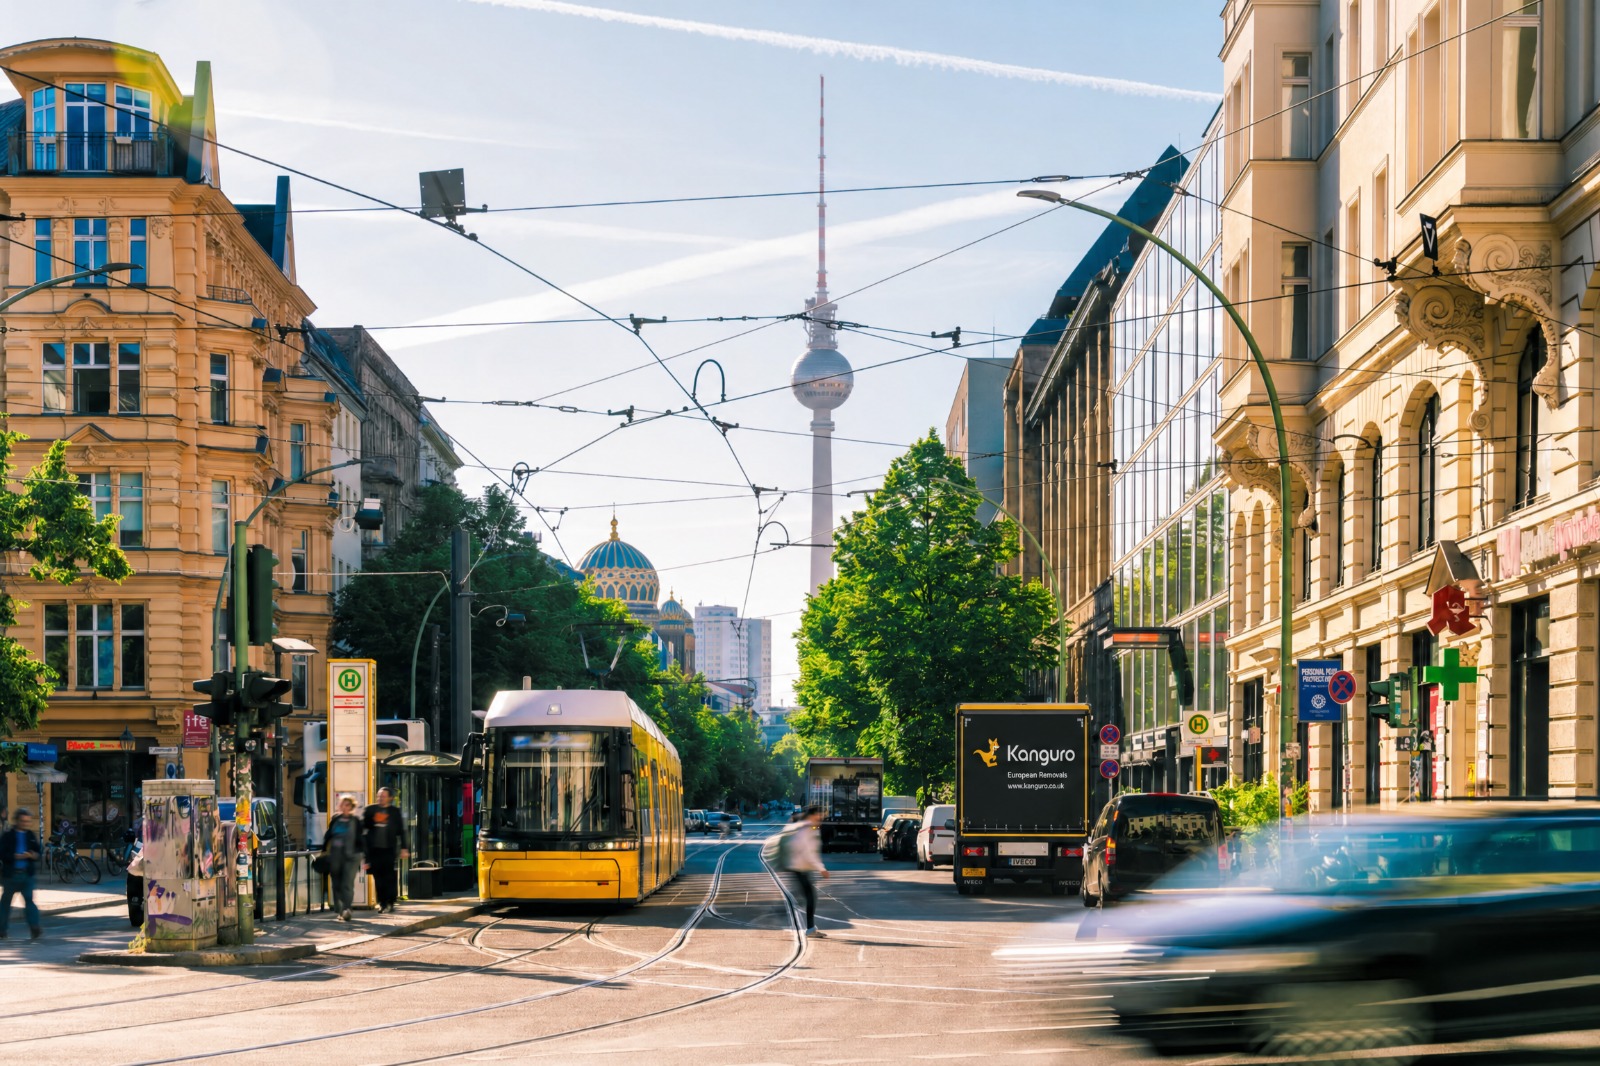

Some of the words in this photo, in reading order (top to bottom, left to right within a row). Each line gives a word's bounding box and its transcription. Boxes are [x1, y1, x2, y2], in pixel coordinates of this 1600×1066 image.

[344, 673, 356, 687] H
[1193, 718, 1204, 730] H
[1007, 744, 1076, 766] Kanguro
[1007, 771, 1038, 780] European
[1038, 771, 1068, 779] Removals
[1007, 782, 1065, 791] www.kanguro.co.uk
[1013, 858, 1035, 866] IVECO
